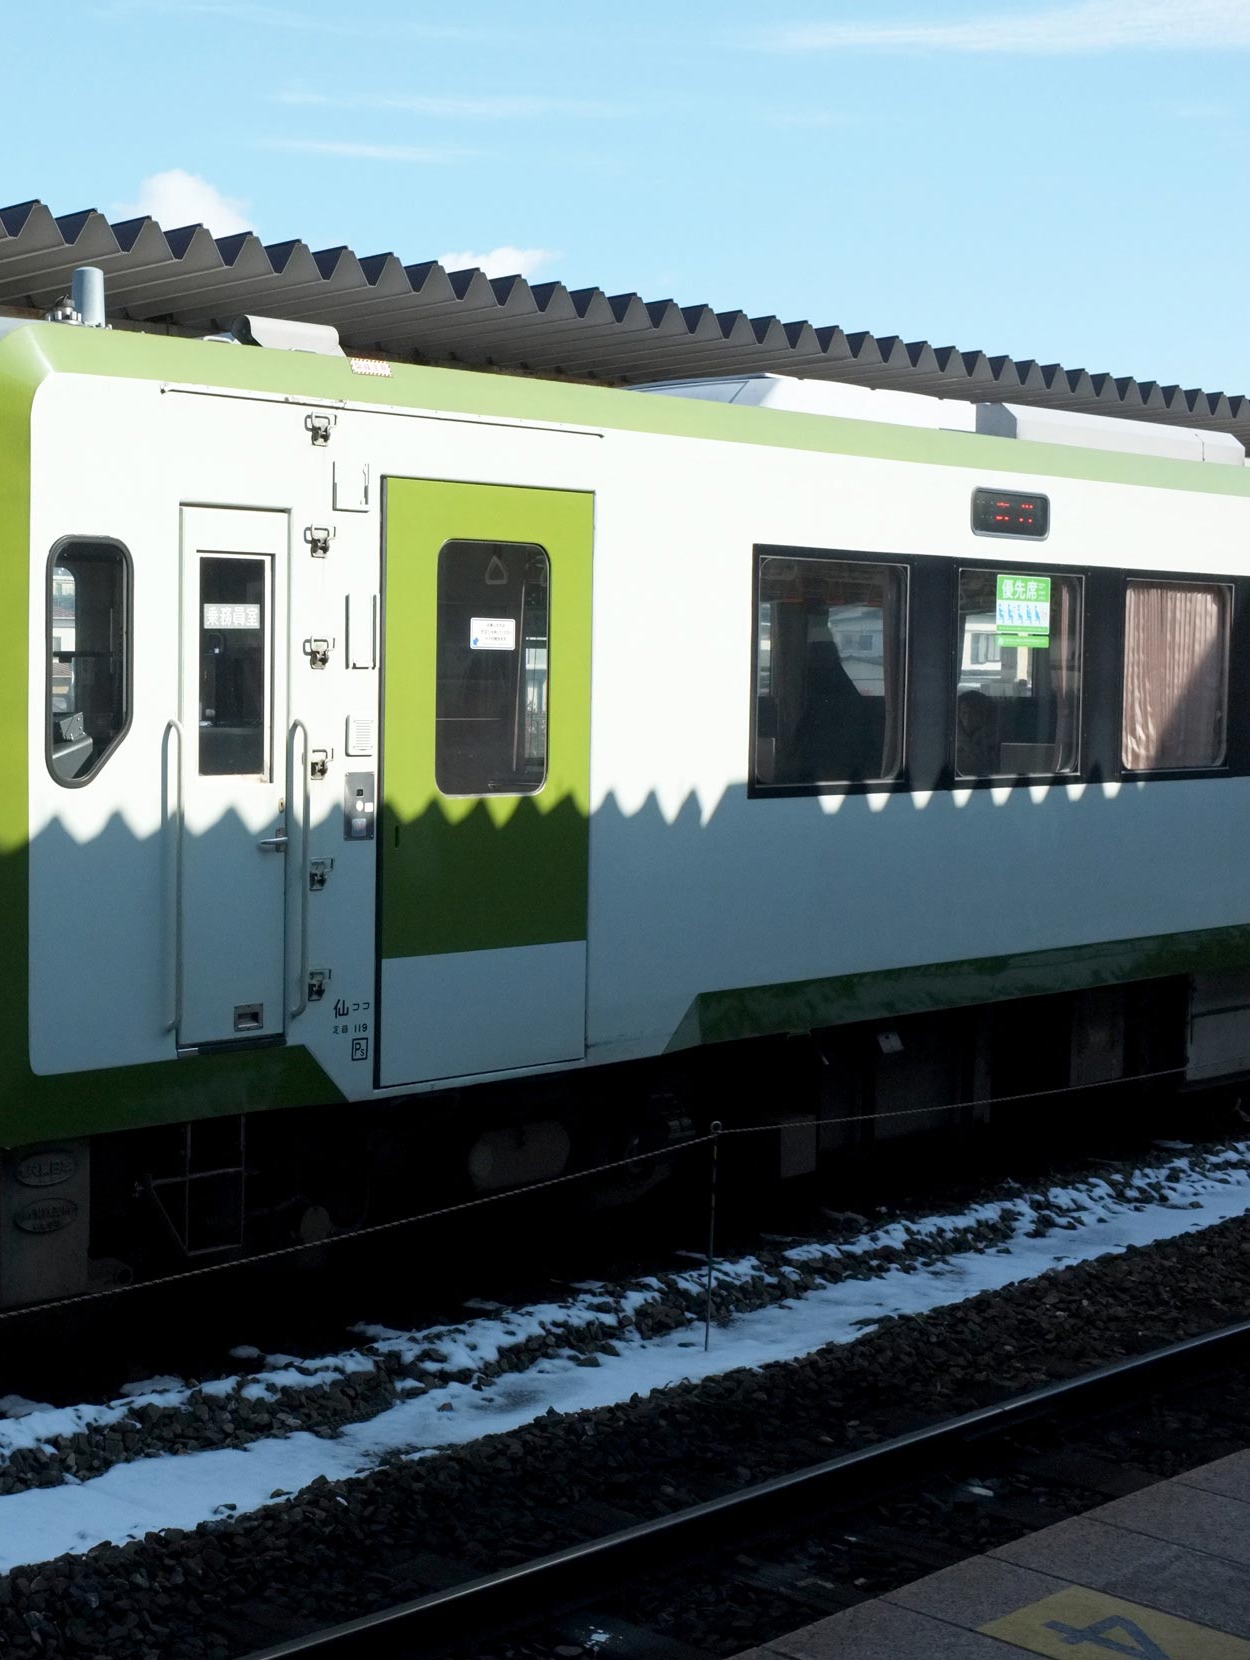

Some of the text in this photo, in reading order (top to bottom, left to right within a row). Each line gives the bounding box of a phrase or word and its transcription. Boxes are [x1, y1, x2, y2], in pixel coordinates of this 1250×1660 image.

[1001, 578, 1038, 600] 優先席
[206, 606, 259, 626] 乗務員室
[354, 1023, 368, 1033] 119
